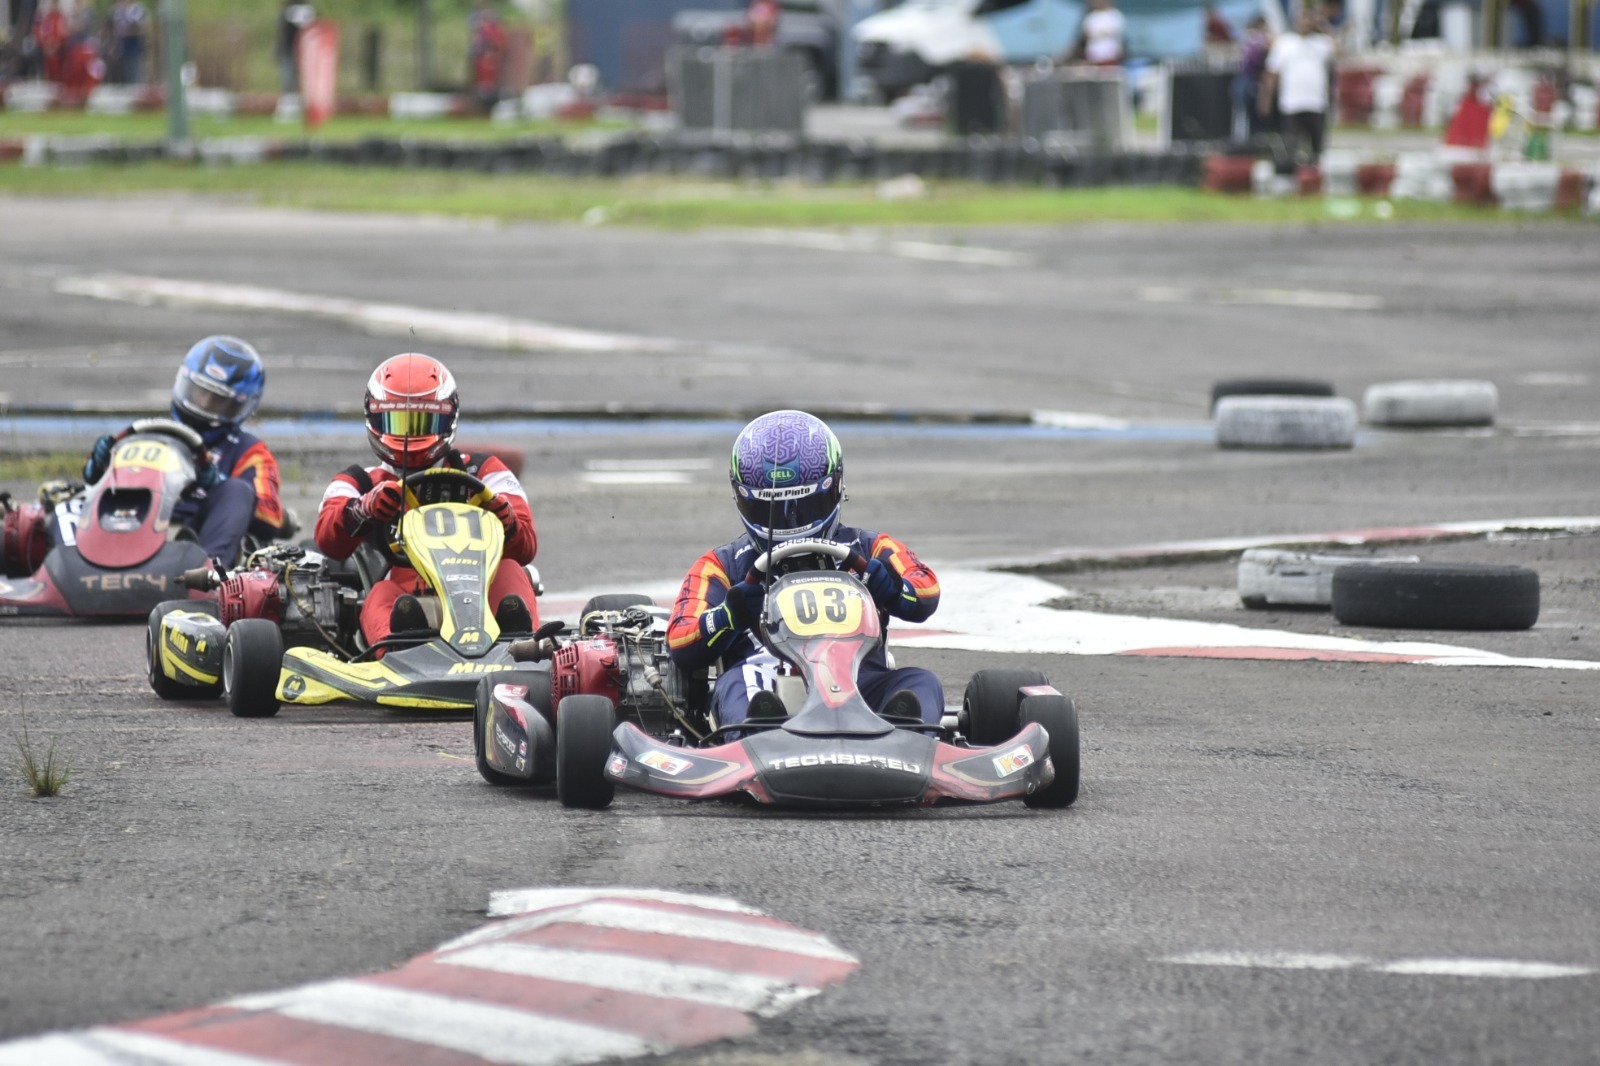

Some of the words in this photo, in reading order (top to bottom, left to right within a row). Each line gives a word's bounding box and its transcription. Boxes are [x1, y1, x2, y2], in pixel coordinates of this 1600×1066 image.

[120, 445, 161, 461] 00
[770, 471, 792, 479] BELL
[758, 490, 783, 498] Filipe
[784, 487, 811, 497] Pinto
[424, 507, 483, 541] 01
[790, 577, 842, 585] TECHSPEED
[793, 587, 848, 625] 03
[769, 754, 921, 774] TECHSPEED
